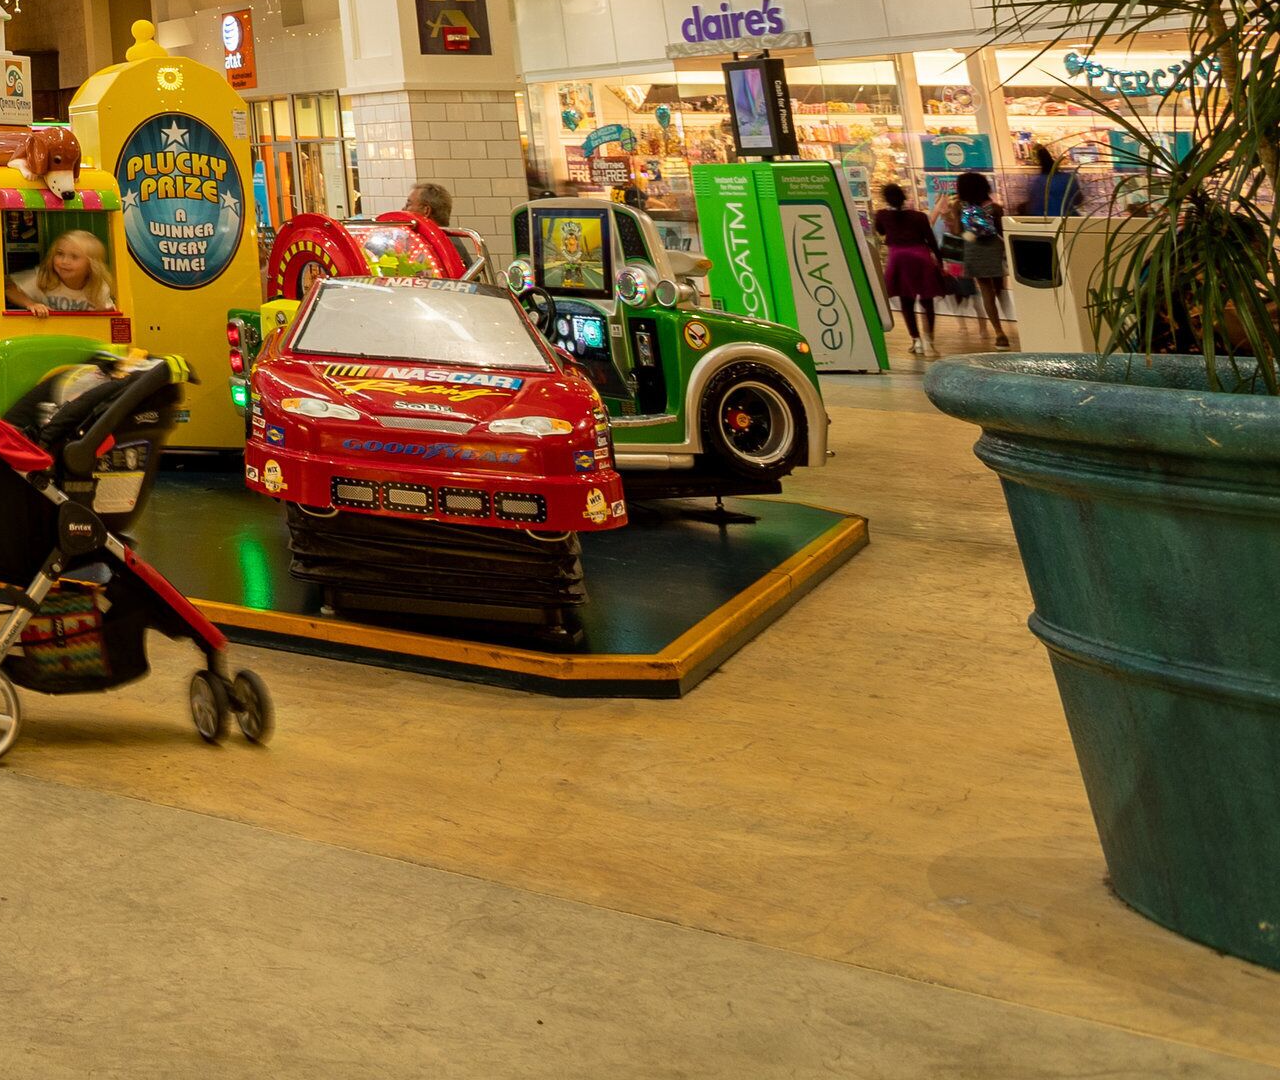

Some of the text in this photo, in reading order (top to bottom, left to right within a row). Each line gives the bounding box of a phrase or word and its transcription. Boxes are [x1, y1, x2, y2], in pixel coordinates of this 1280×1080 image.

[682, 0, 783, 42] claire's
[775, 80, 789, 134] Cash for Phones
[127, 151, 227, 182] PLUCKY
[605, 169, 628, 182] FREE
[714, 176, 748, 184] Instant Cash
[781, 175, 830, 183] Instant Cash
[140, 174, 220, 203] PRIZE
[175, 209, 187, 222] A
[150, 221, 214, 238] WINNER
[158, 241, 208, 255] EVERY
[162, 256, 206, 271] TIME!
[386, 277, 471, 294] NASCAR
[383, 367, 516, 389] NASCAR
[342, 439, 522, 464] GOODYEAR
